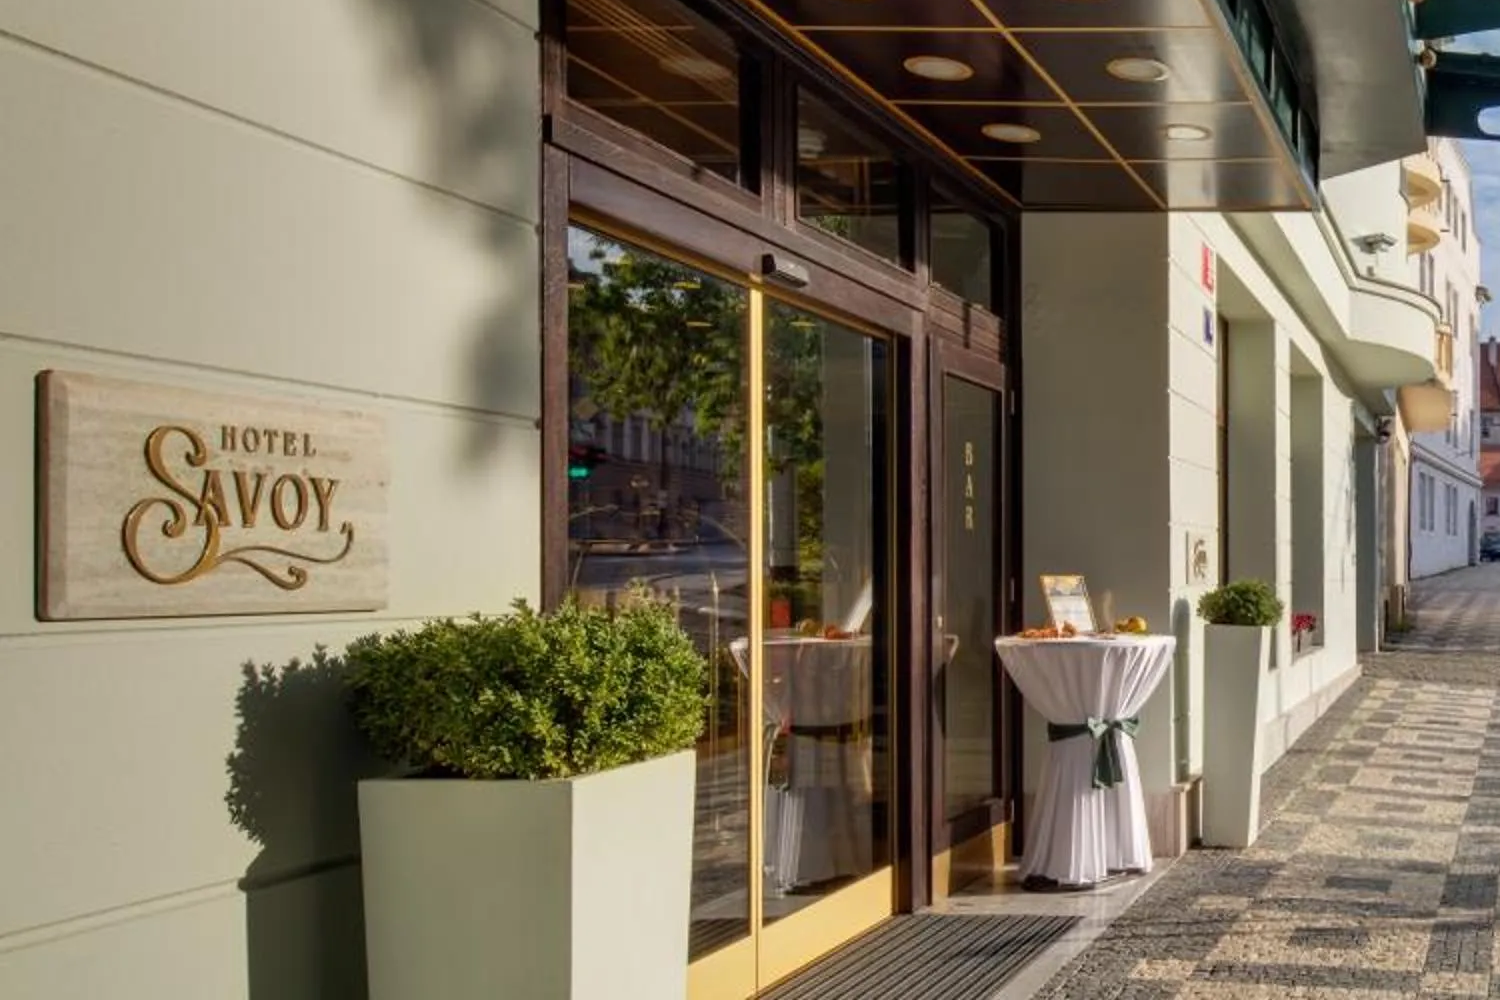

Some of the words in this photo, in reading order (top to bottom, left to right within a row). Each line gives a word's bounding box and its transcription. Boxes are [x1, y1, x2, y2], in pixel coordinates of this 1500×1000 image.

[219, 424, 318, 458] HOTEL
[964, 441, 974, 530] BAR
[122, 425, 353, 590] SAVOY
